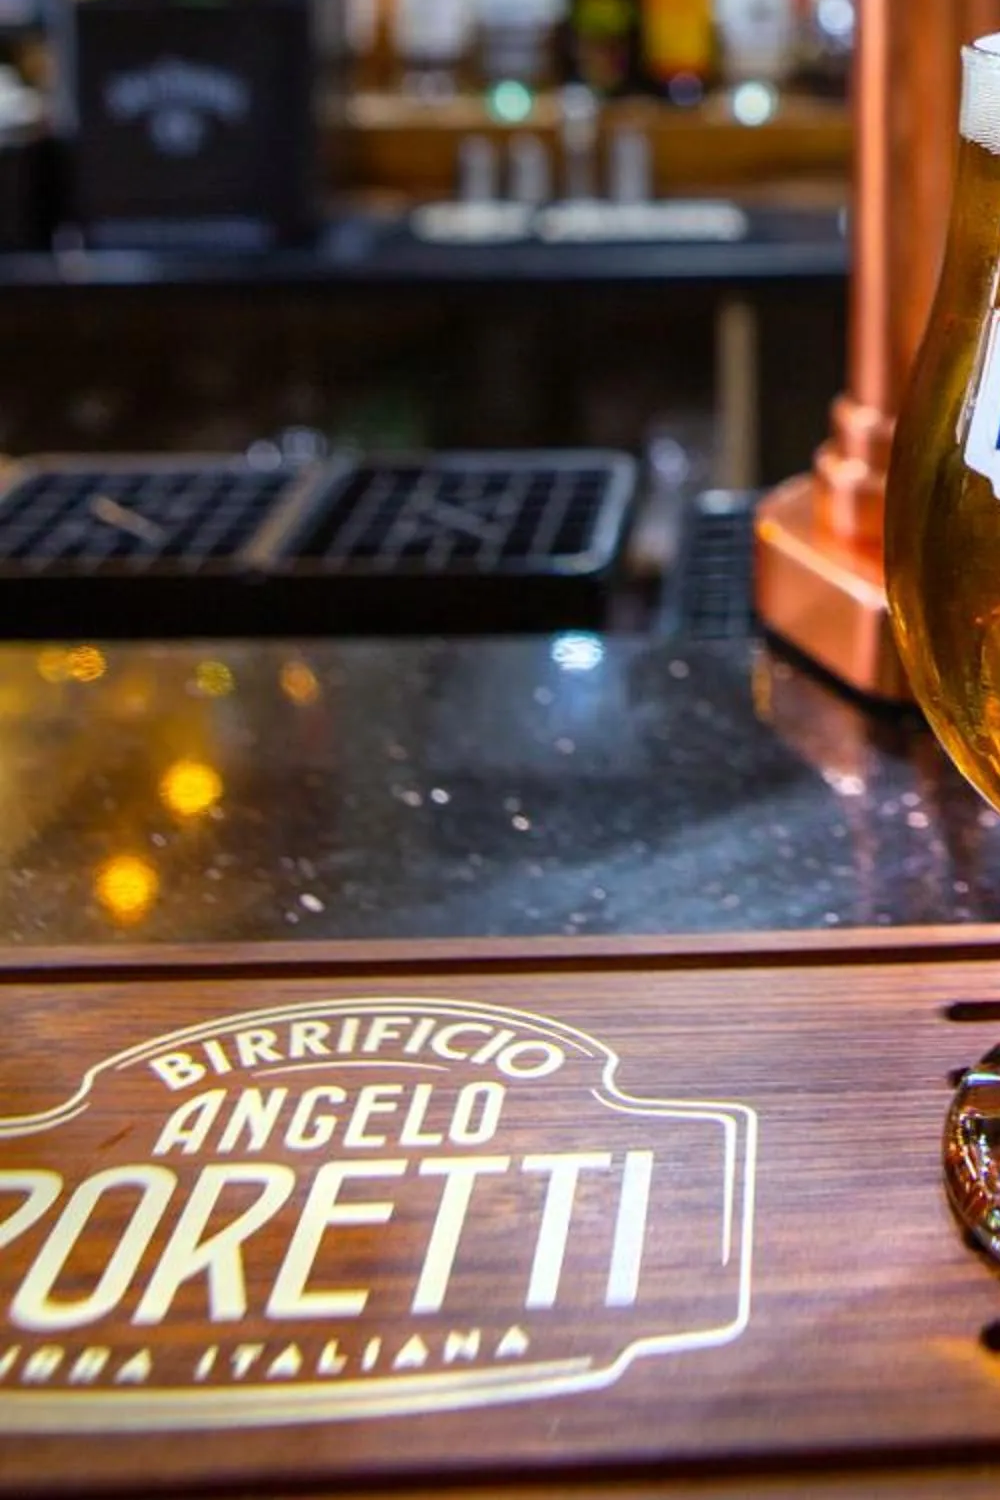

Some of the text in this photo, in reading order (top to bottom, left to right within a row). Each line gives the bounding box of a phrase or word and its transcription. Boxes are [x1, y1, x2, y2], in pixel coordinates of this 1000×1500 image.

[147, 1014, 566, 1092] BIRRIFICIO
[150, 1081, 508, 1158] ANGELO
[0, 1324, 531, 1385] IRRA ITALIANA
